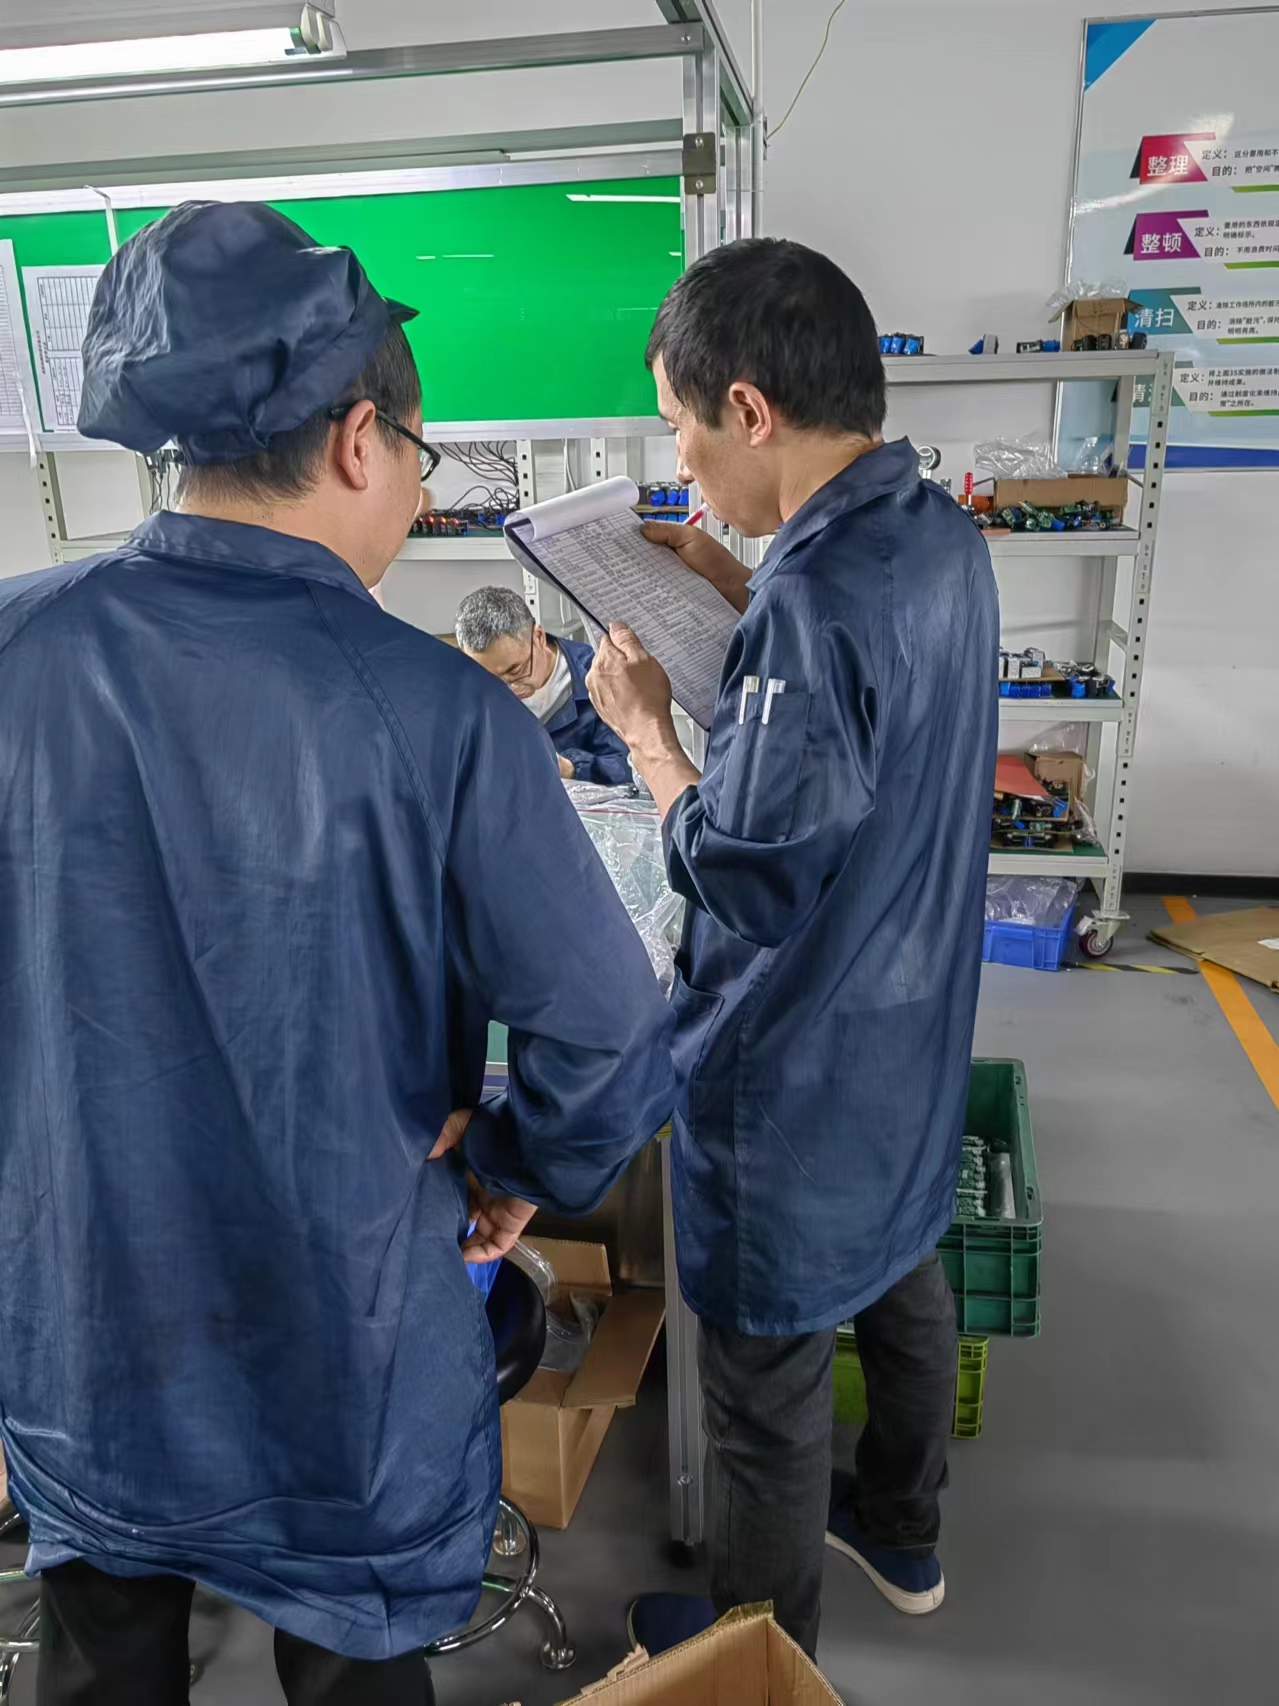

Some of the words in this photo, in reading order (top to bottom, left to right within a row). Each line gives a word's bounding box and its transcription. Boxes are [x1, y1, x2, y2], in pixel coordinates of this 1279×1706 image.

[1147, 155, 1188, 176] 整理
[1140, 233, 1182, 254] 整顿
[1134, 308, 1174, 328] 清扫
